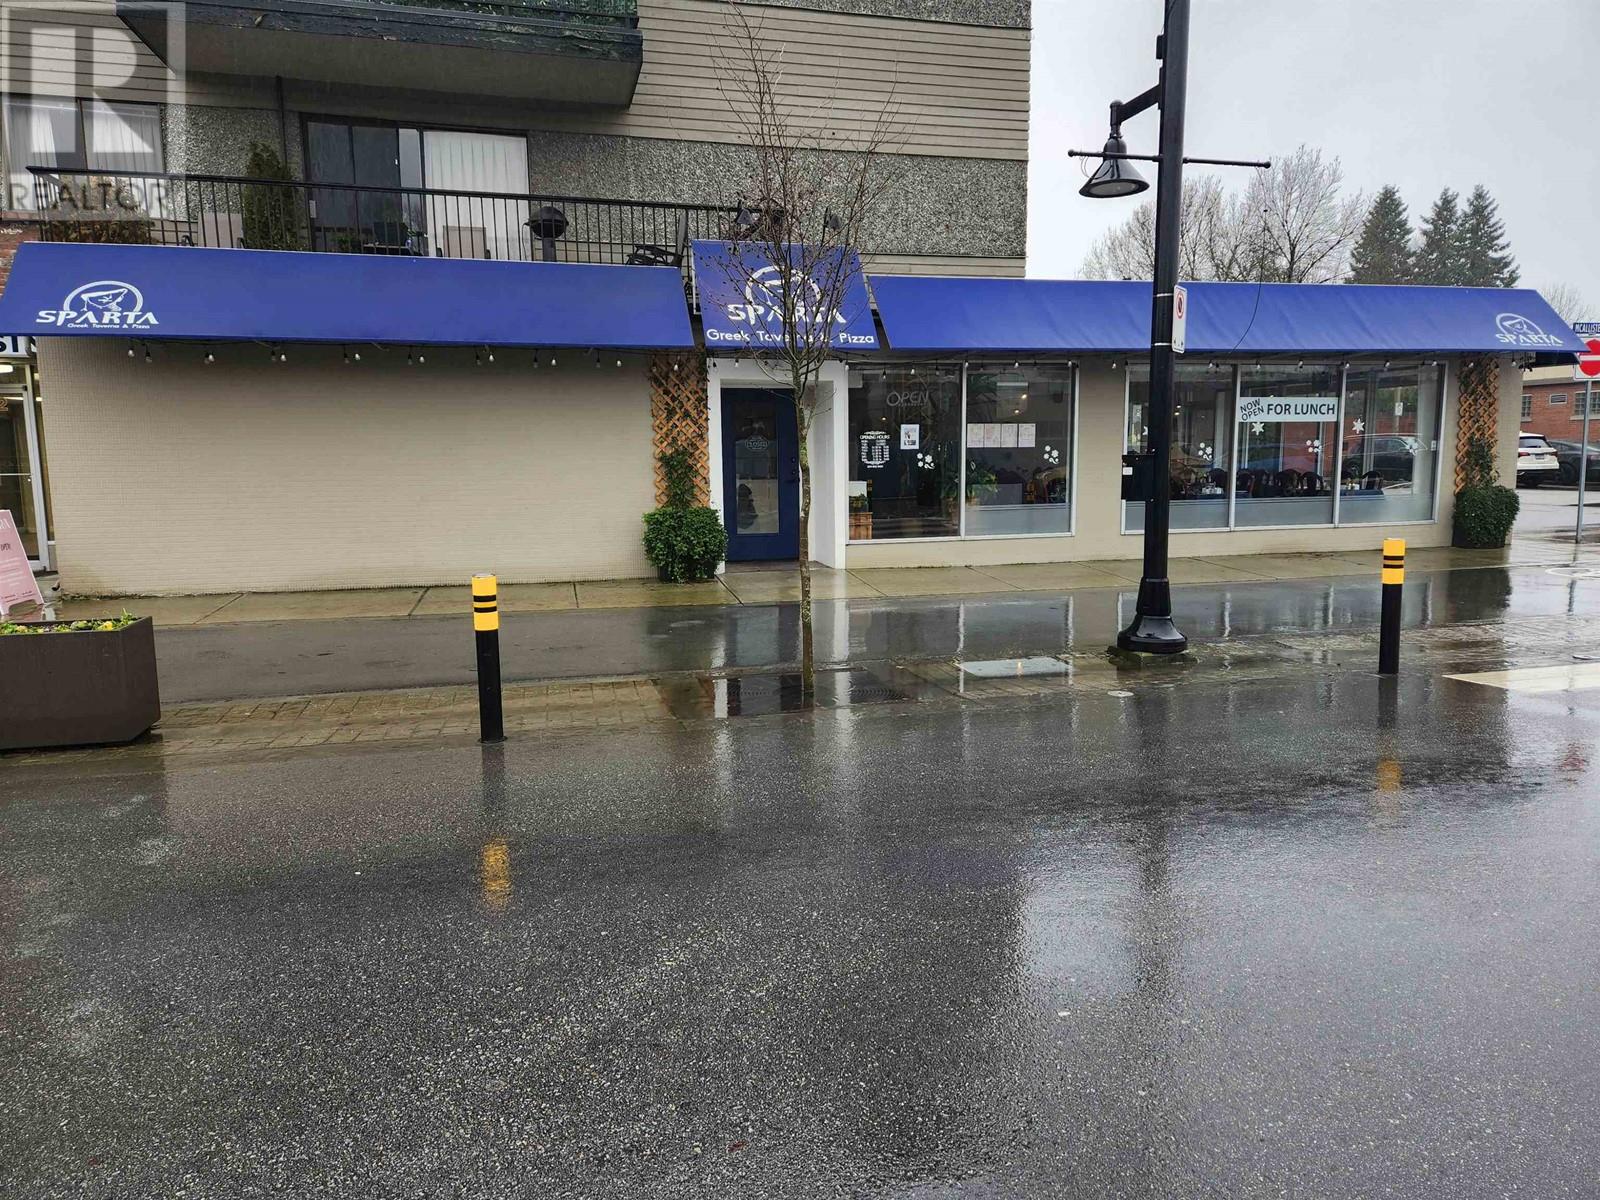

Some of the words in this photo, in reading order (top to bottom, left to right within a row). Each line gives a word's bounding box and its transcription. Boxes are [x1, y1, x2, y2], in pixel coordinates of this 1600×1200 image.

[36, 310, 159, 326] SPARTA
[727, 303, 847, 325] SPARTA
[706, 329, 750, 341] Greek
[756, 331, 814, 343] Tavena
[839, 332, 875, 343] Pizza
[1495, 333, 1564, 346] SPARTA
[886, 390, 929, 406] OPEN
[1240, 398, 1261, 413] NOW
[1241, 406, 1265, 421] OPEN
[1266, 403, 1292, 415] FOR
[1294, 403, 1336, 415] LUNCH
